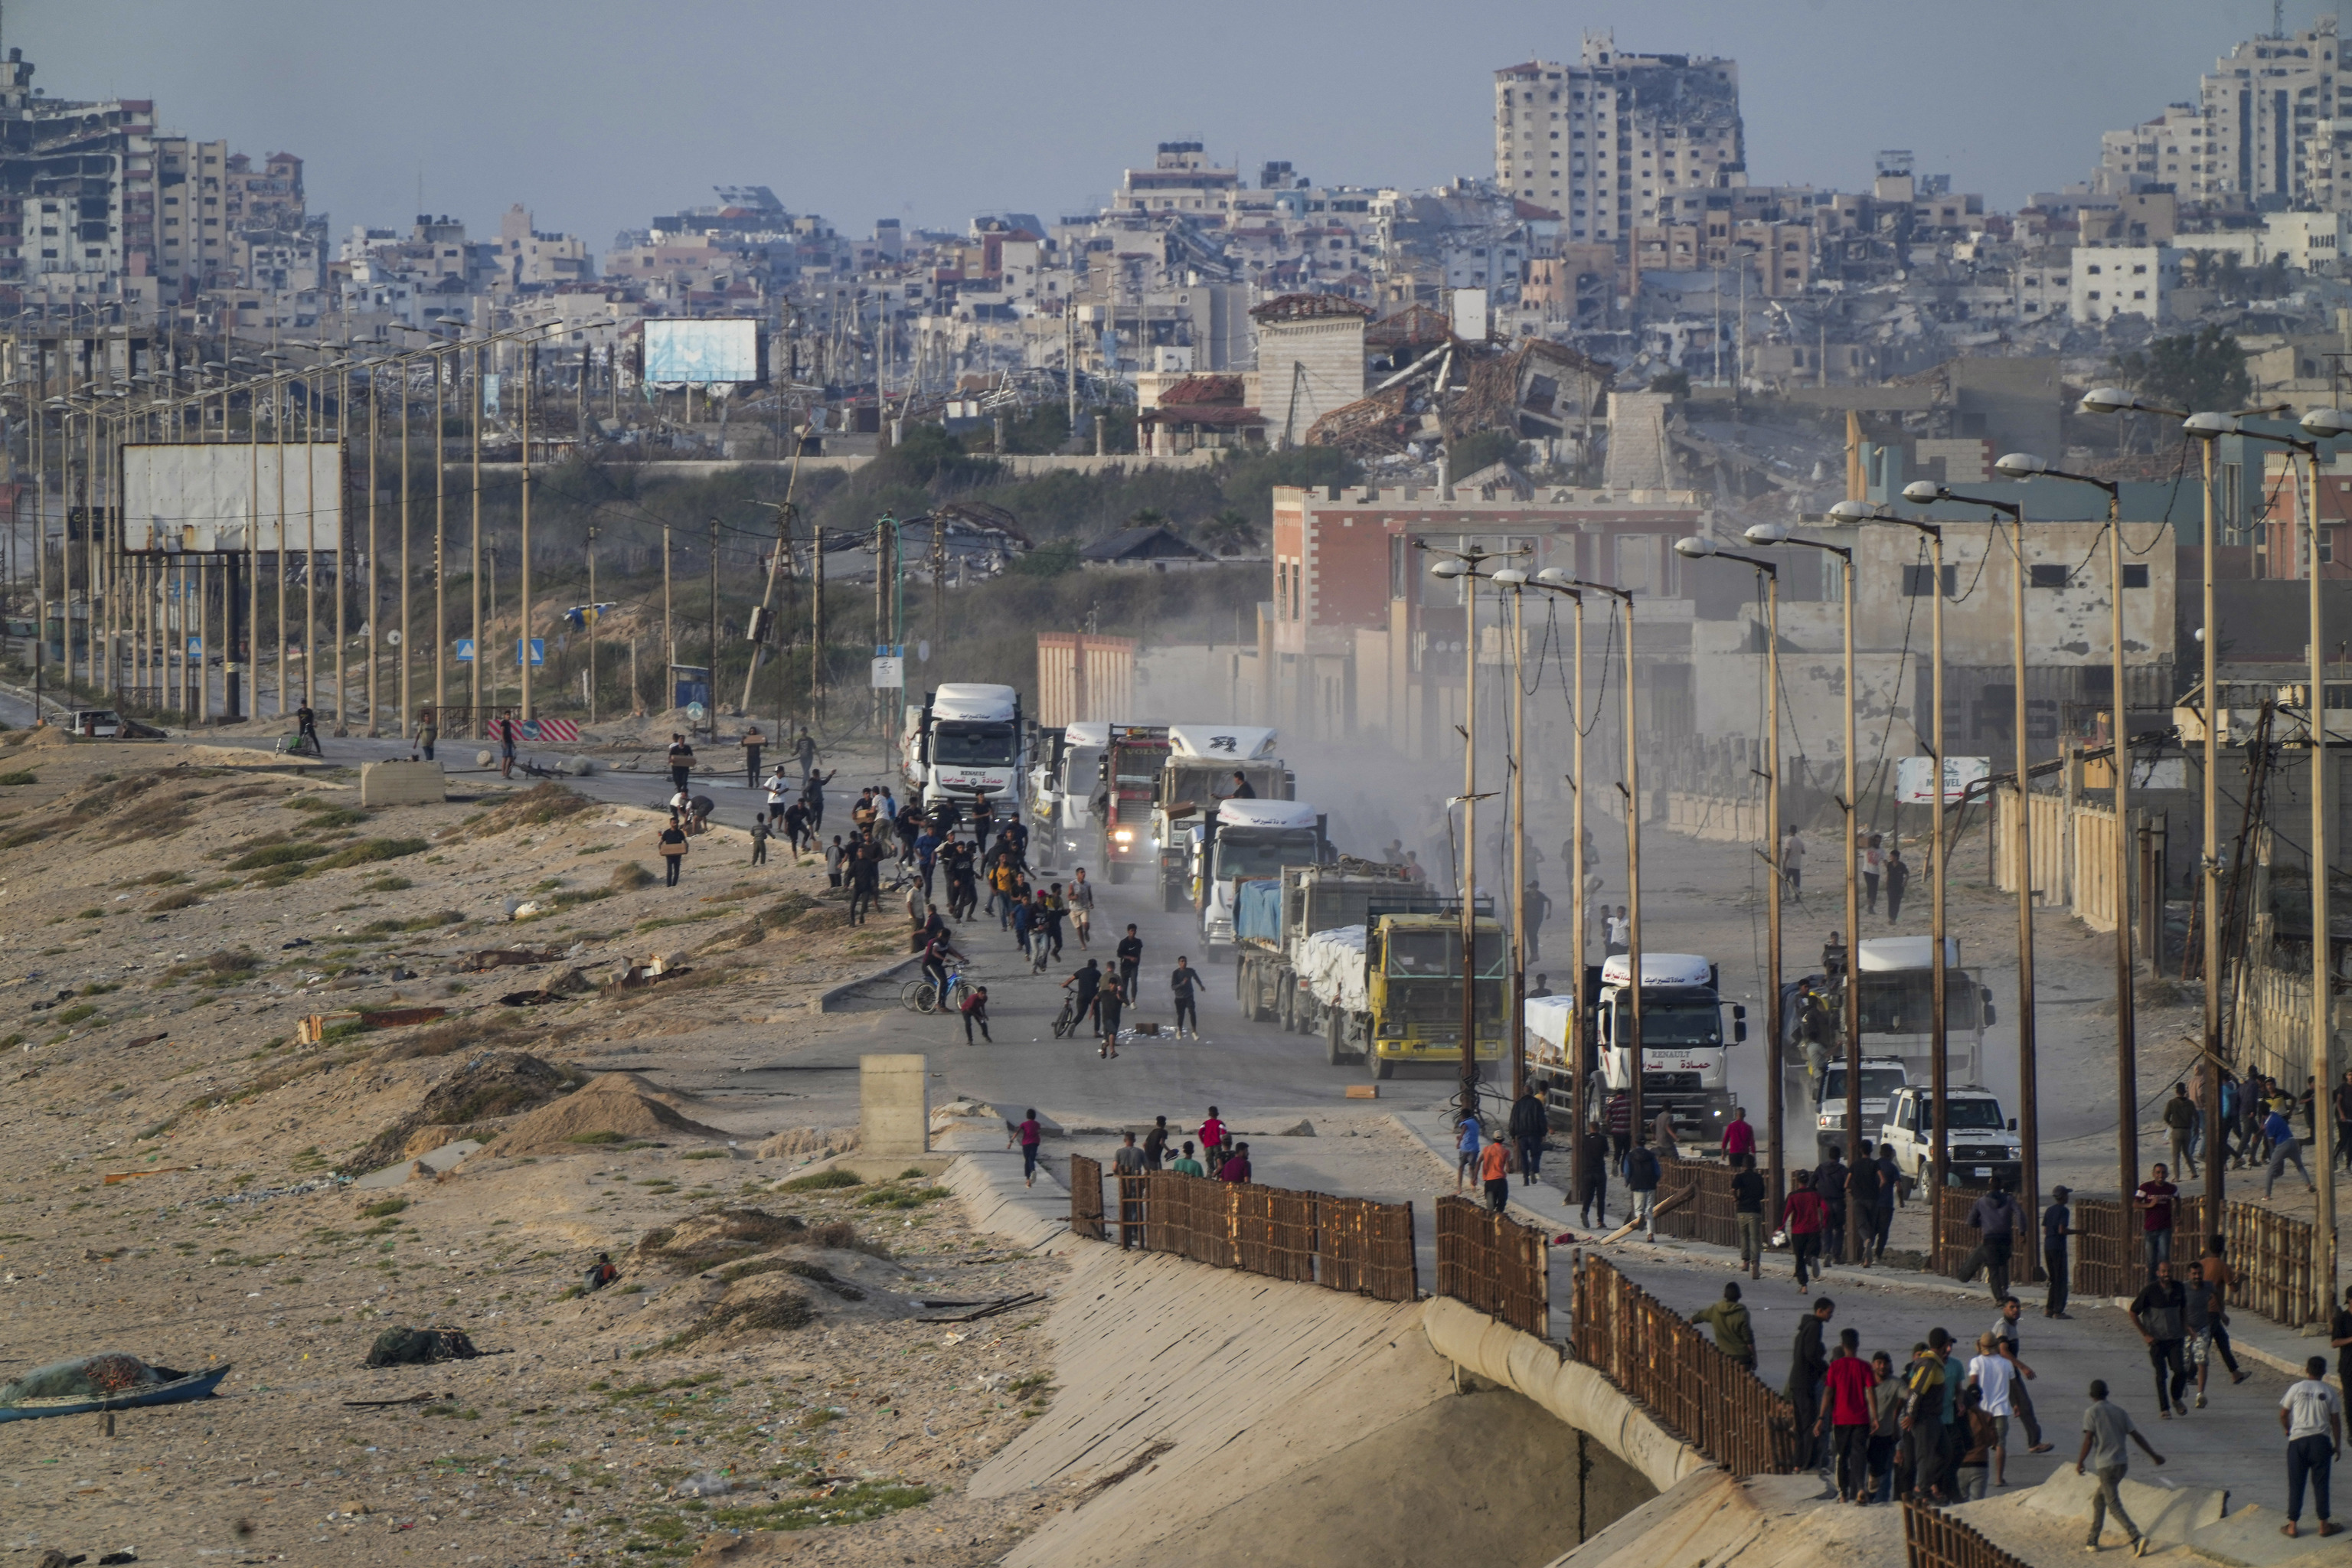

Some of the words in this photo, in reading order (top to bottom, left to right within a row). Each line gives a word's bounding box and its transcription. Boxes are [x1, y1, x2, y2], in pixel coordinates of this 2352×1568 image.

[1926, 779, 1962, 787] MVEL
[1644, 976, 1671, 985] للسيراميك
[1642, 1060, 1663, 1070] للسيرا
[1681, 1060, 1710, 1069] حمادة
